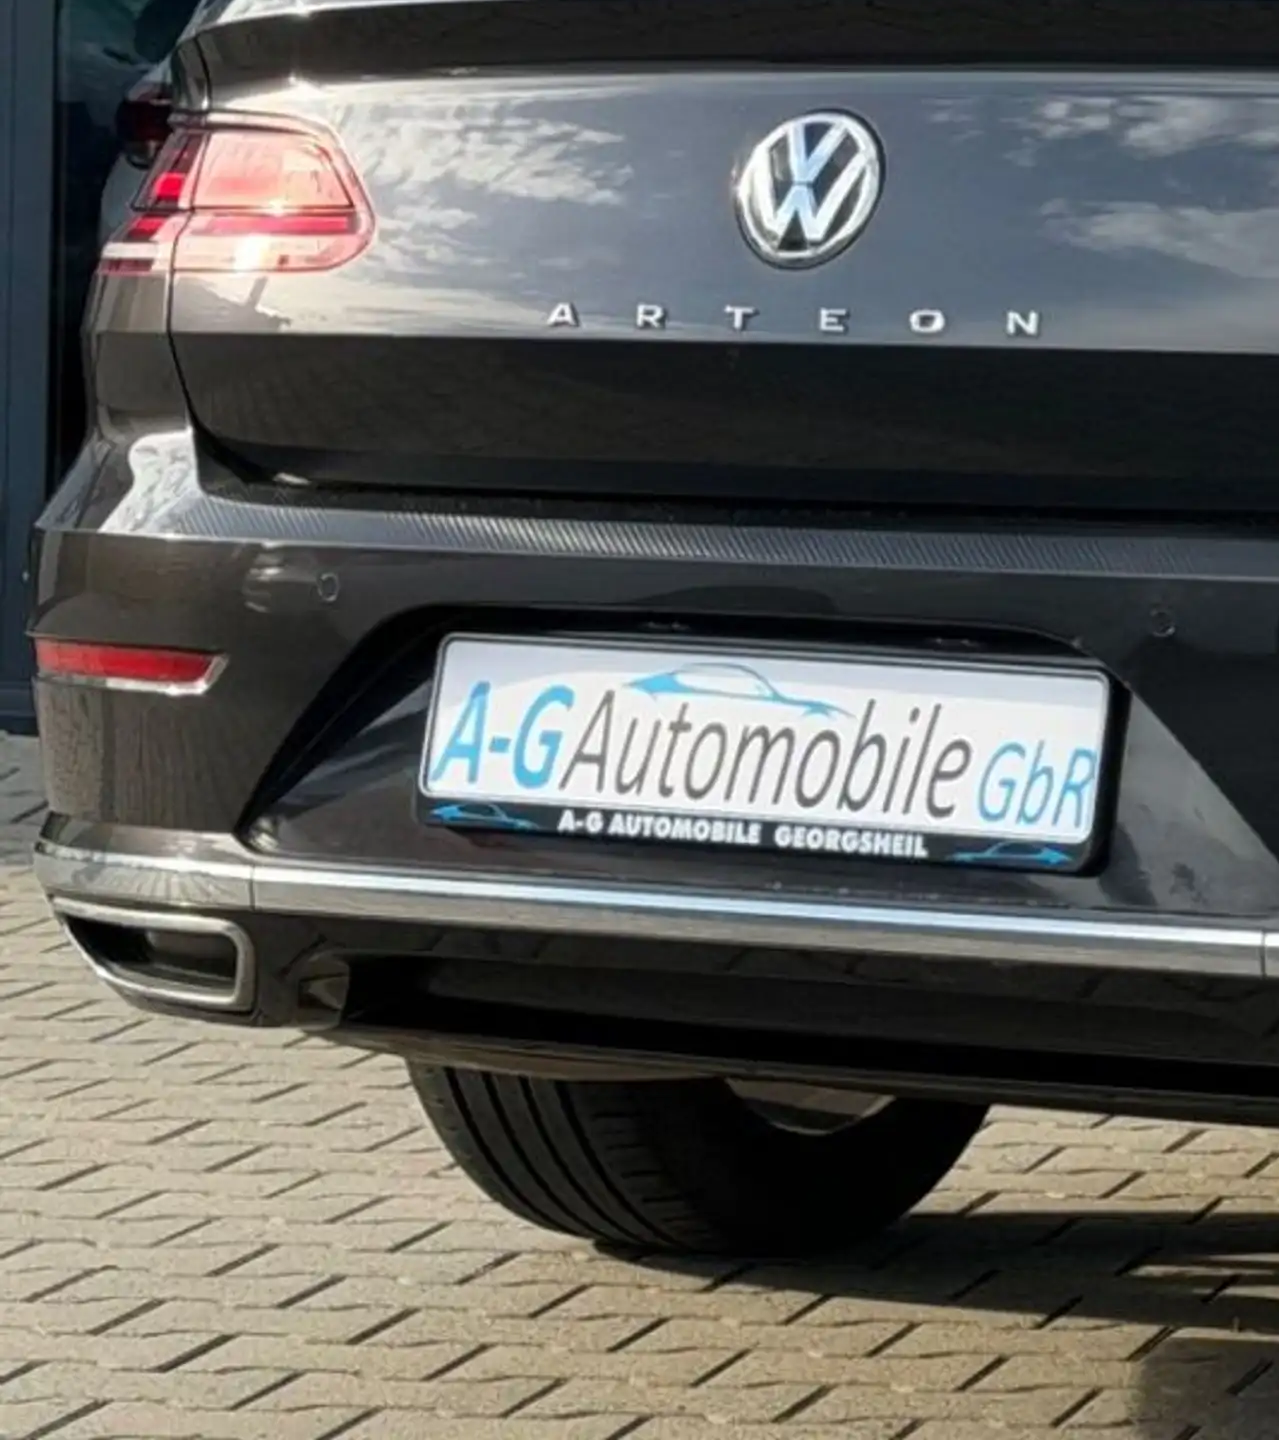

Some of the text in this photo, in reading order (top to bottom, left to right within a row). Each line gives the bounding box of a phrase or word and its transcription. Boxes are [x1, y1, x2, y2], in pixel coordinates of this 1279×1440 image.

[547, 302, 1041, 339] ARTEON
[430, 680, 1099, 829] A-G Automobile GbR
[556, 808, 929, 859] A-G AUTOMOBILE GEORGSHEIL
